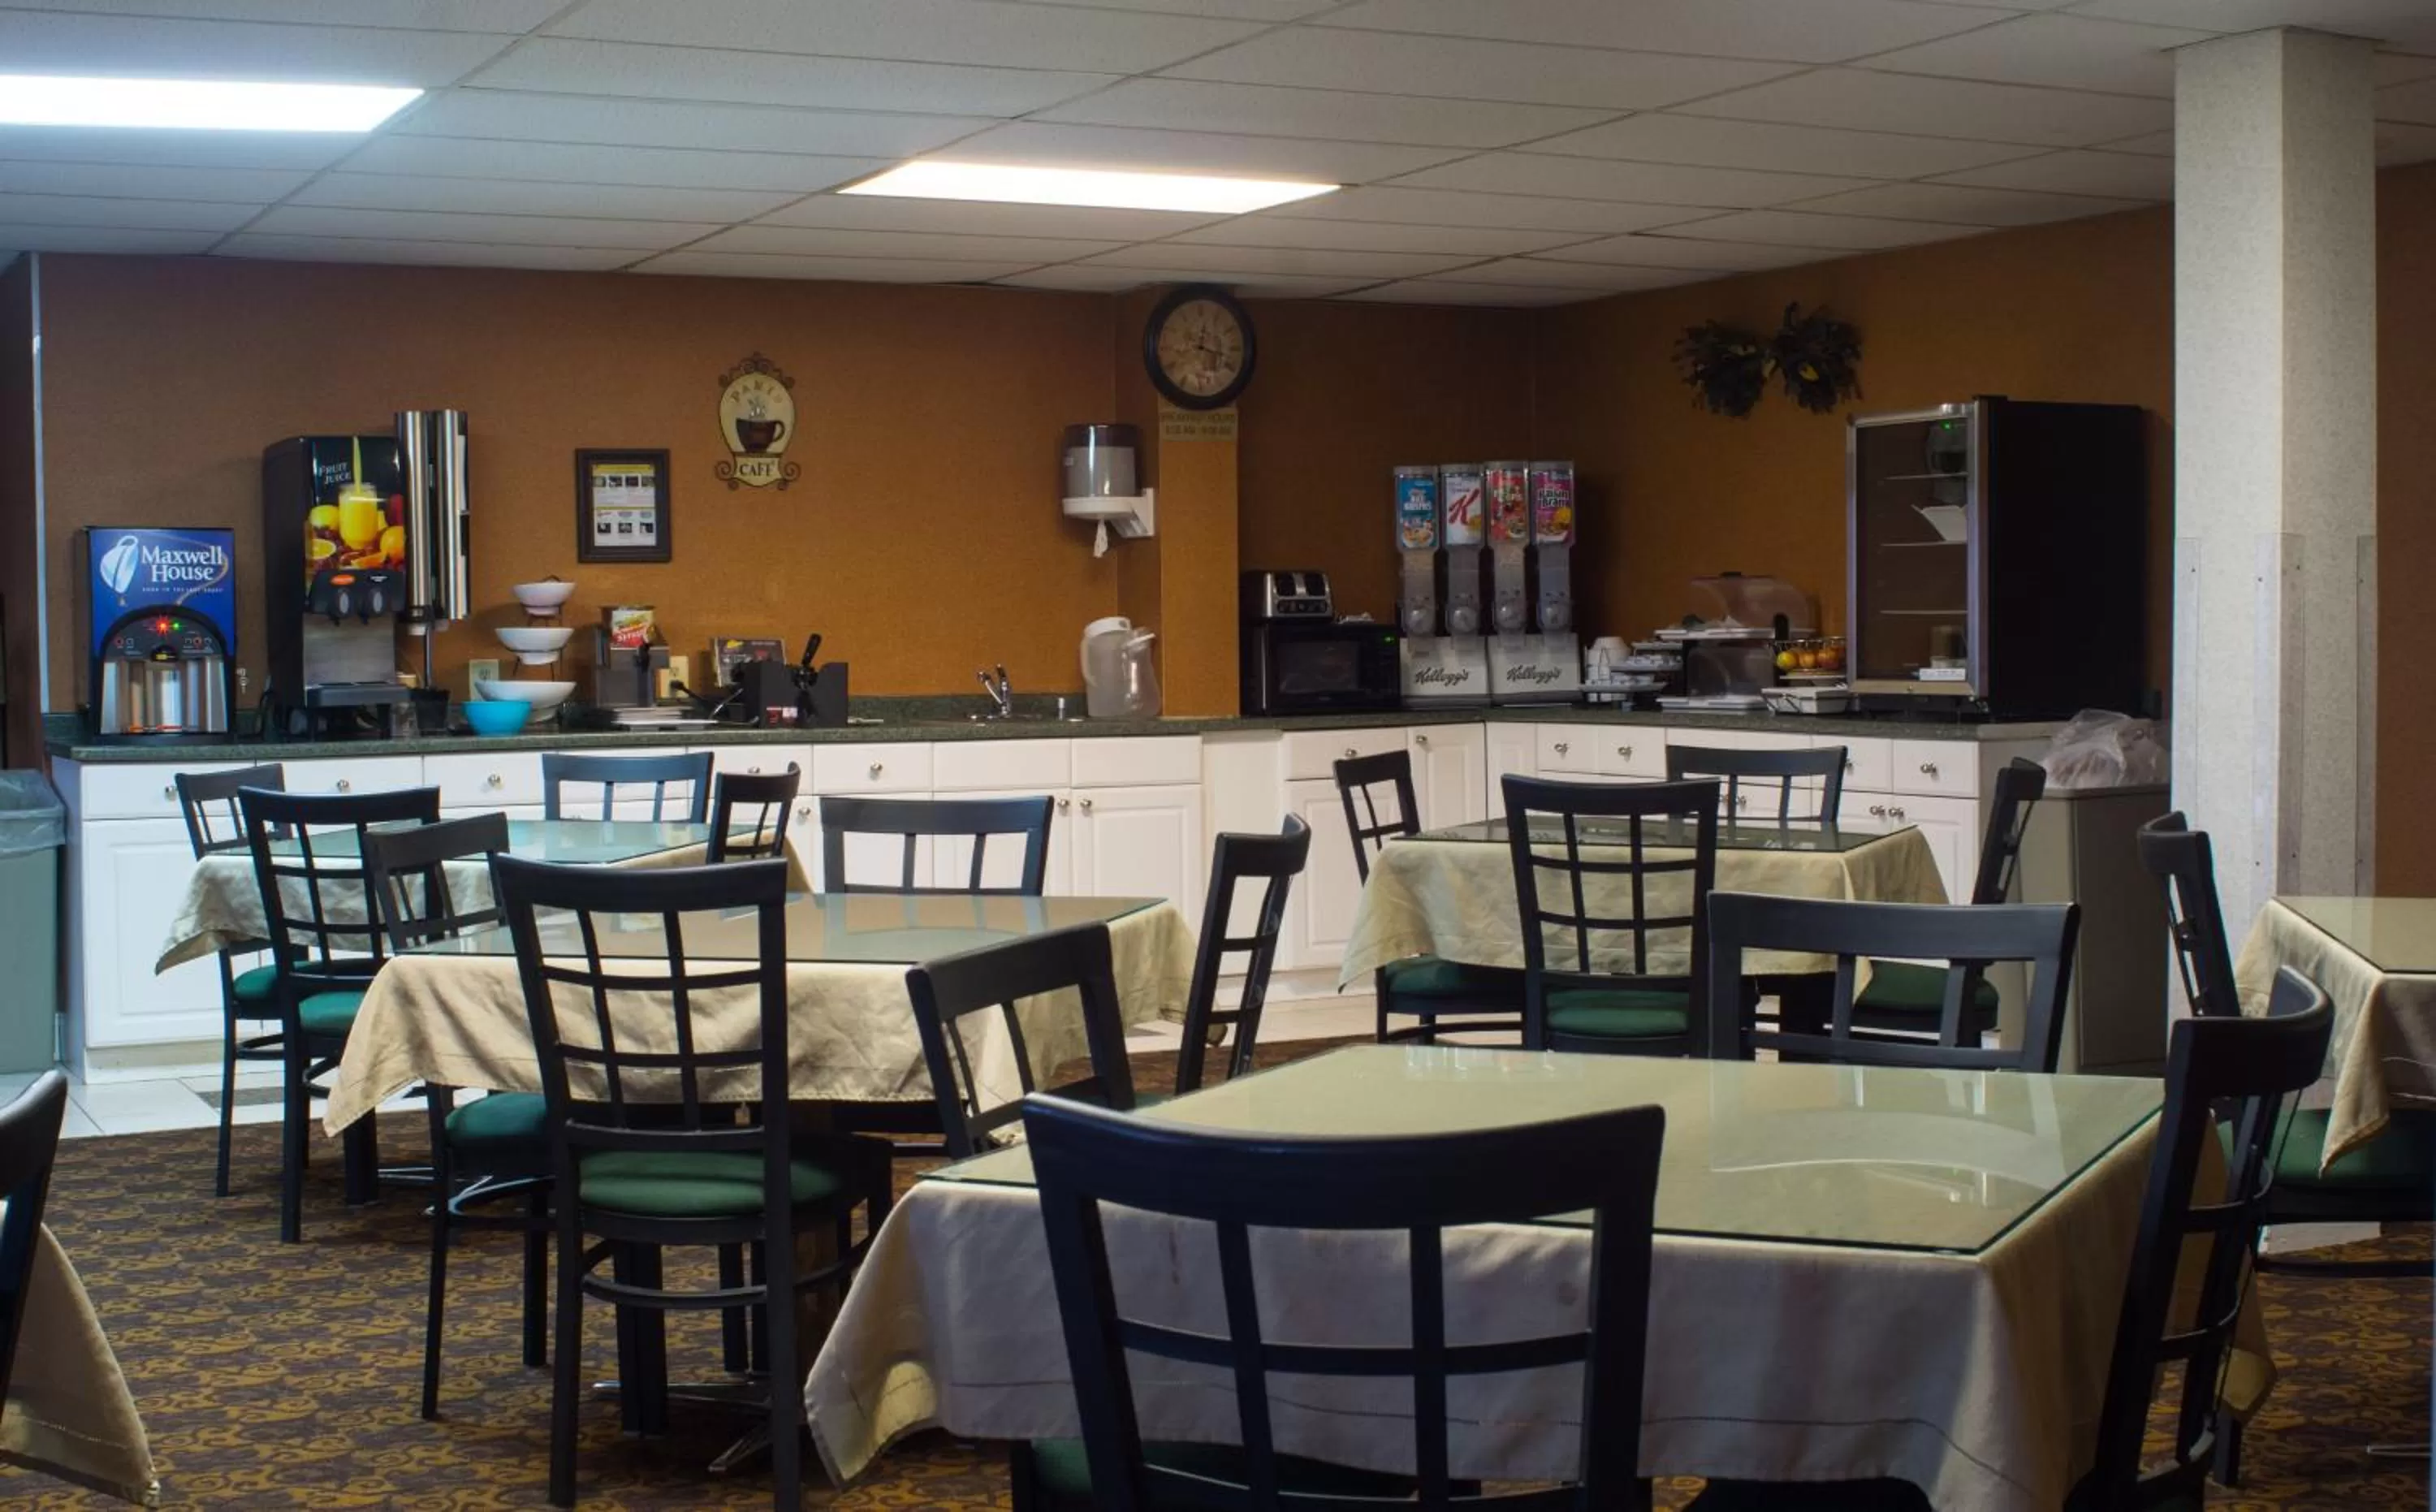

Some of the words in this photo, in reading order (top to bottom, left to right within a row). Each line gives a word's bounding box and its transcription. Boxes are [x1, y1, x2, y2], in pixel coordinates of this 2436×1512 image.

[317, 461, 349, 477] FRUIT
[324, 470, 352, 485] JUICE
[141, 545, 223, 565] Maxwell
[151, 564, 215, 582] House
[1415, 667, 1470, 687] Kellogg's
[1506, 664, 1563, 685] Kellogg's
